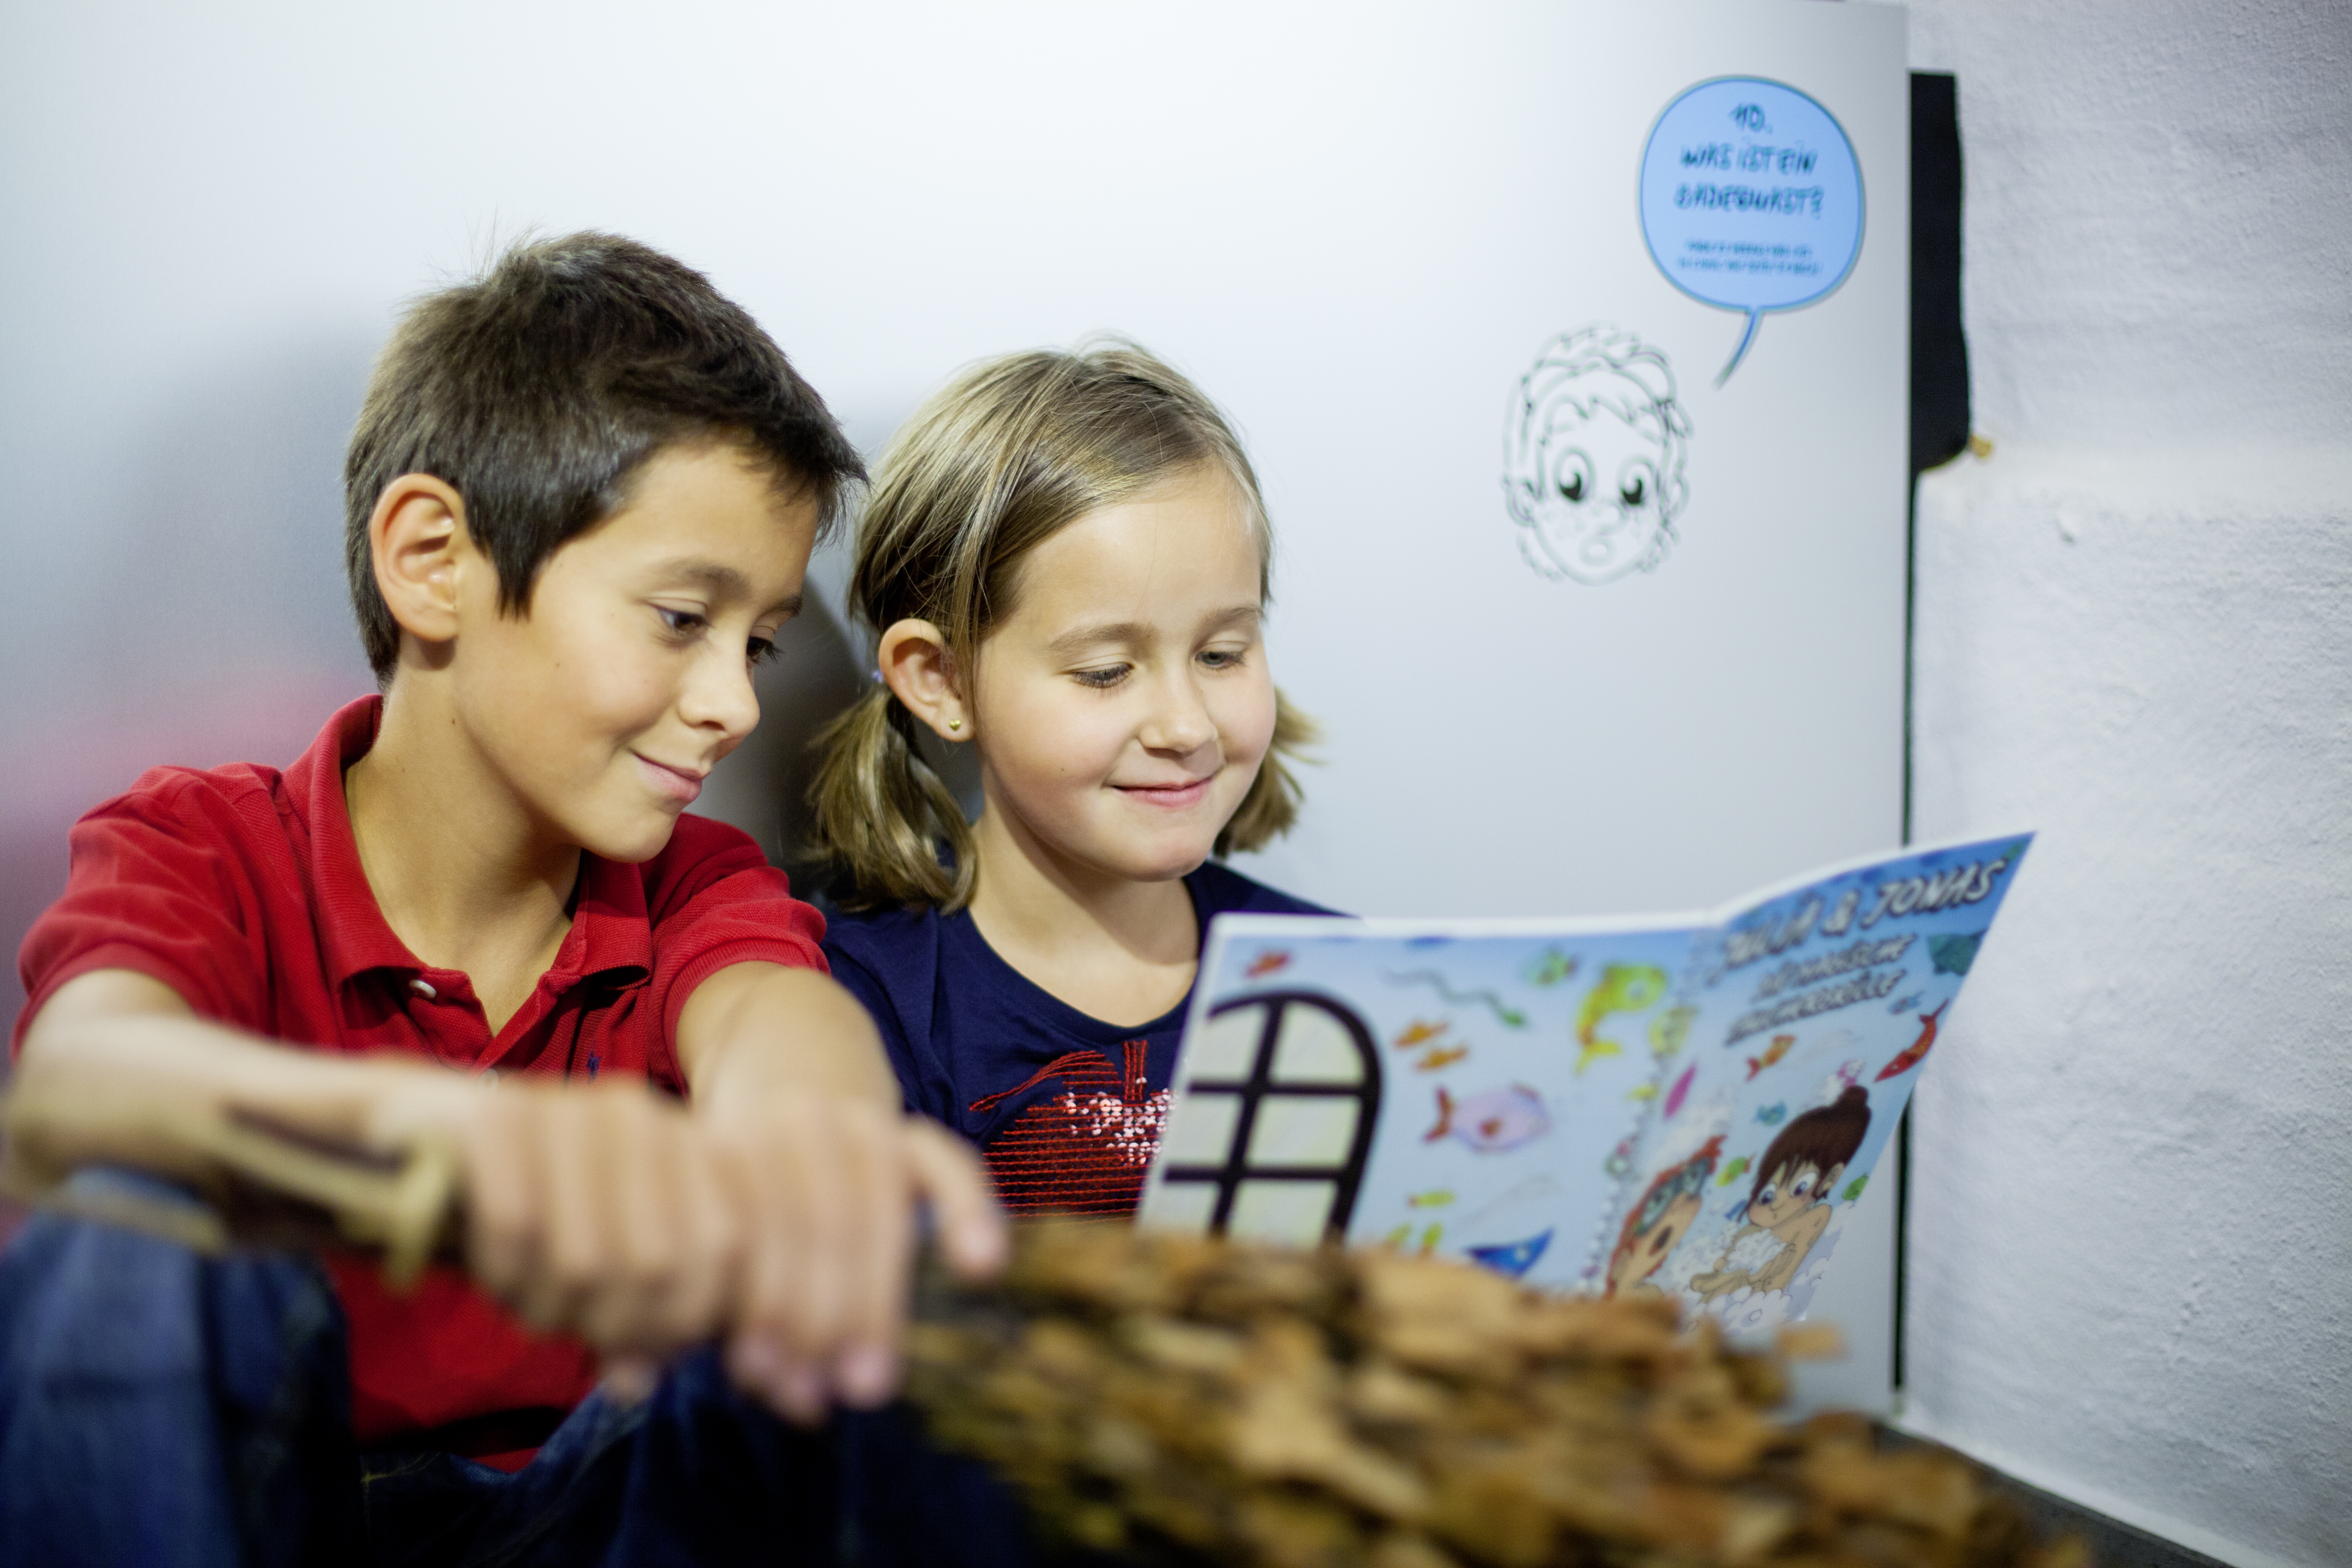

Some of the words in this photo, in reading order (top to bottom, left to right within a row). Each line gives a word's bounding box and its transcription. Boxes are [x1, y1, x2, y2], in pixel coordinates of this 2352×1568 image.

[1681, 142, 1733, 170] WAS
[1777, 142, 1818, 175] EIN
[1860, 857, 2009, 930] JONAS
